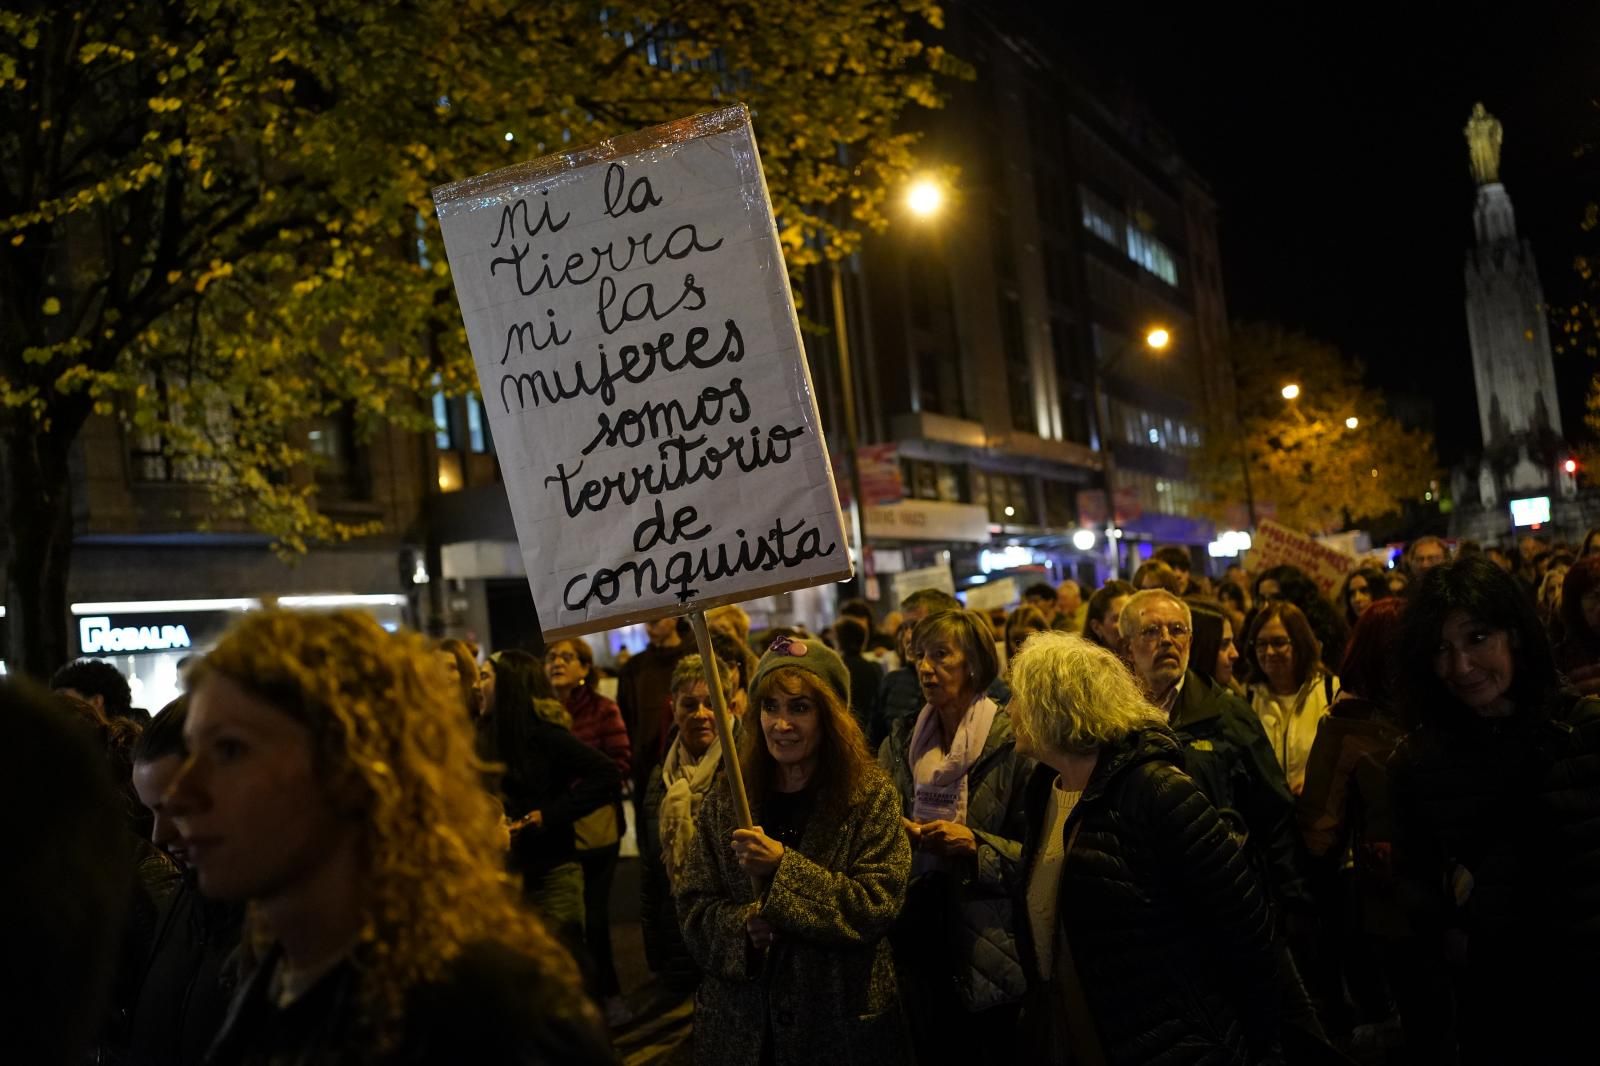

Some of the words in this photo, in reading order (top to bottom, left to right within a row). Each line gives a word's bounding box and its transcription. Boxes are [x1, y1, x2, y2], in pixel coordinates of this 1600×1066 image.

[491, 190, 571, 248] ni
[604, 163, 663, 218] la
[491, 224, 724, 296] tierra
[501, 309, 572, 364] ni
[598, 273, 707, 334] las
[501, 318, 745, 413] mujeres
[582, 377, 751, 455] somos
[545, 424, 805, 518] territorio
[563, 518, 836, 611] conquista
[634, 500, 712, 552] de
